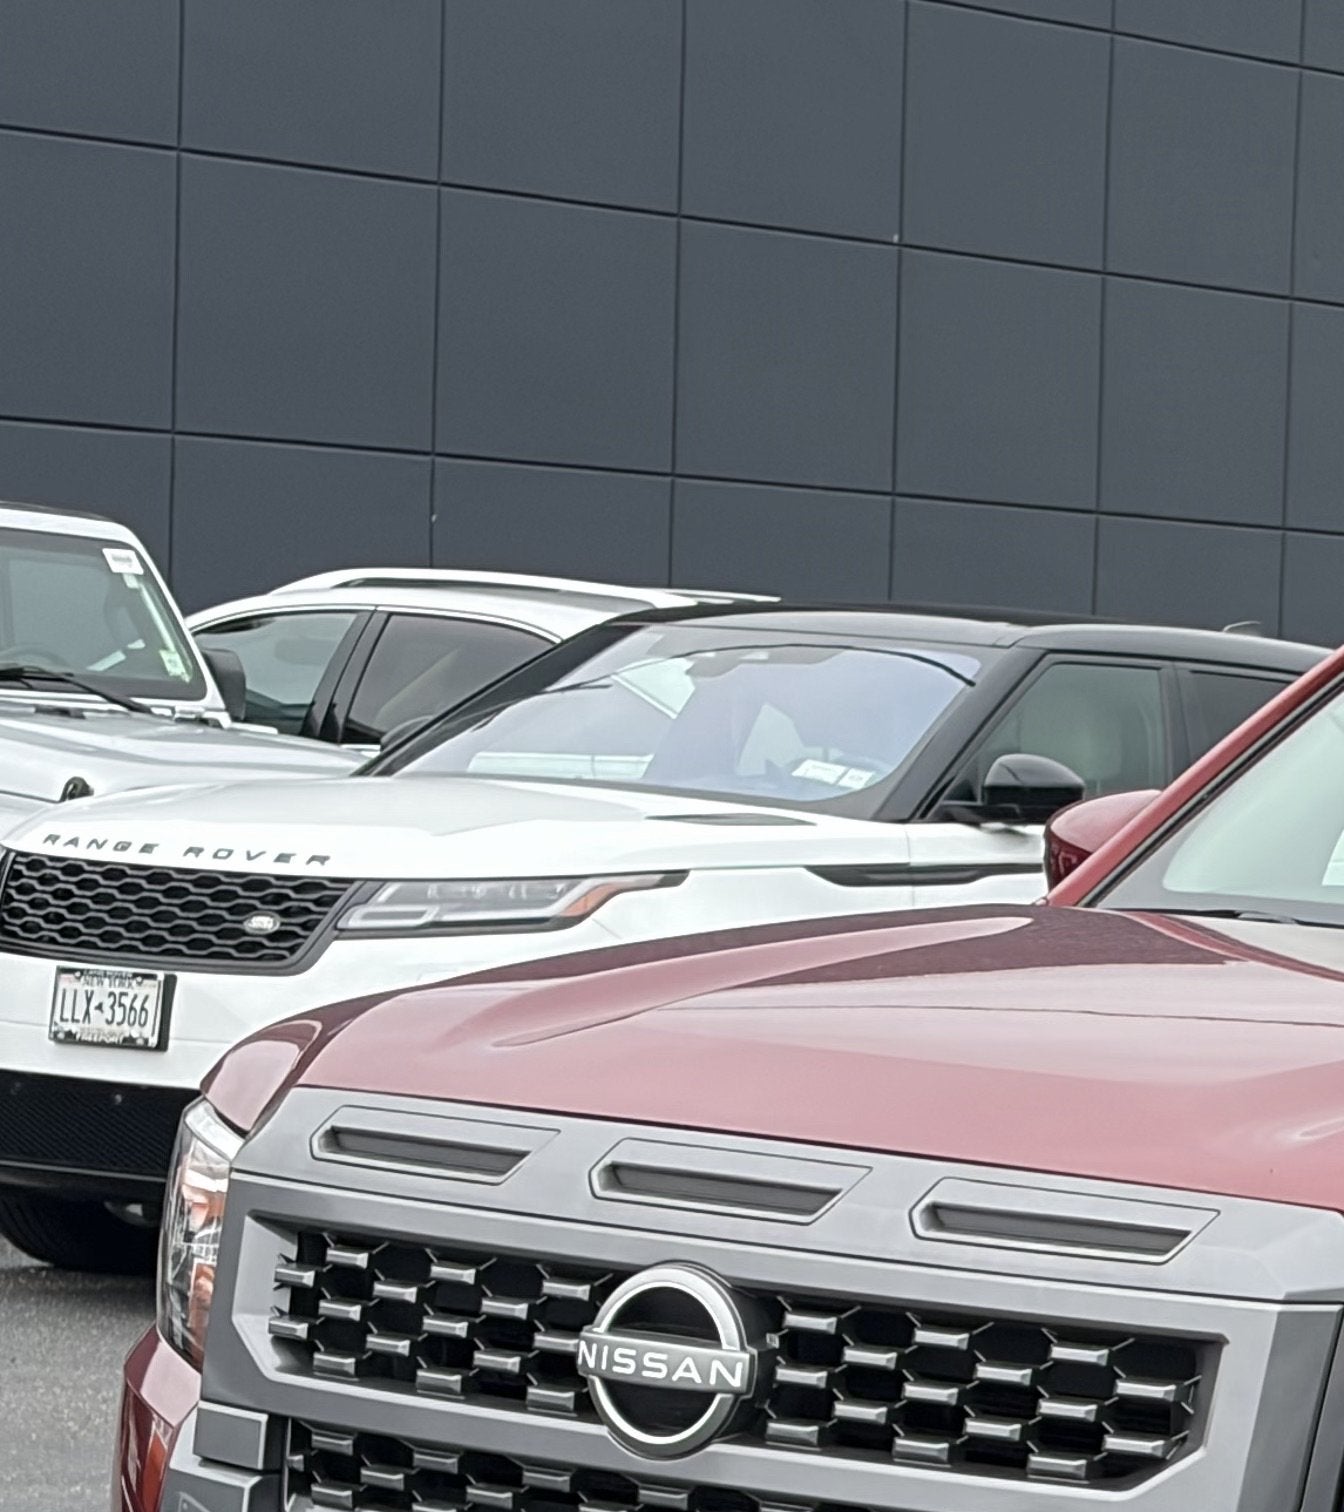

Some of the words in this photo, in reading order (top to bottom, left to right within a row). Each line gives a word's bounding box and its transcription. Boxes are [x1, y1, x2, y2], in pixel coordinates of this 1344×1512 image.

[43, 833, 159, 854] RANGE
[183, 845, 330, 867] ROVER
[105, 991, 149, 1027] 3566
[578, 1340, 744, 1388] NISSAN
